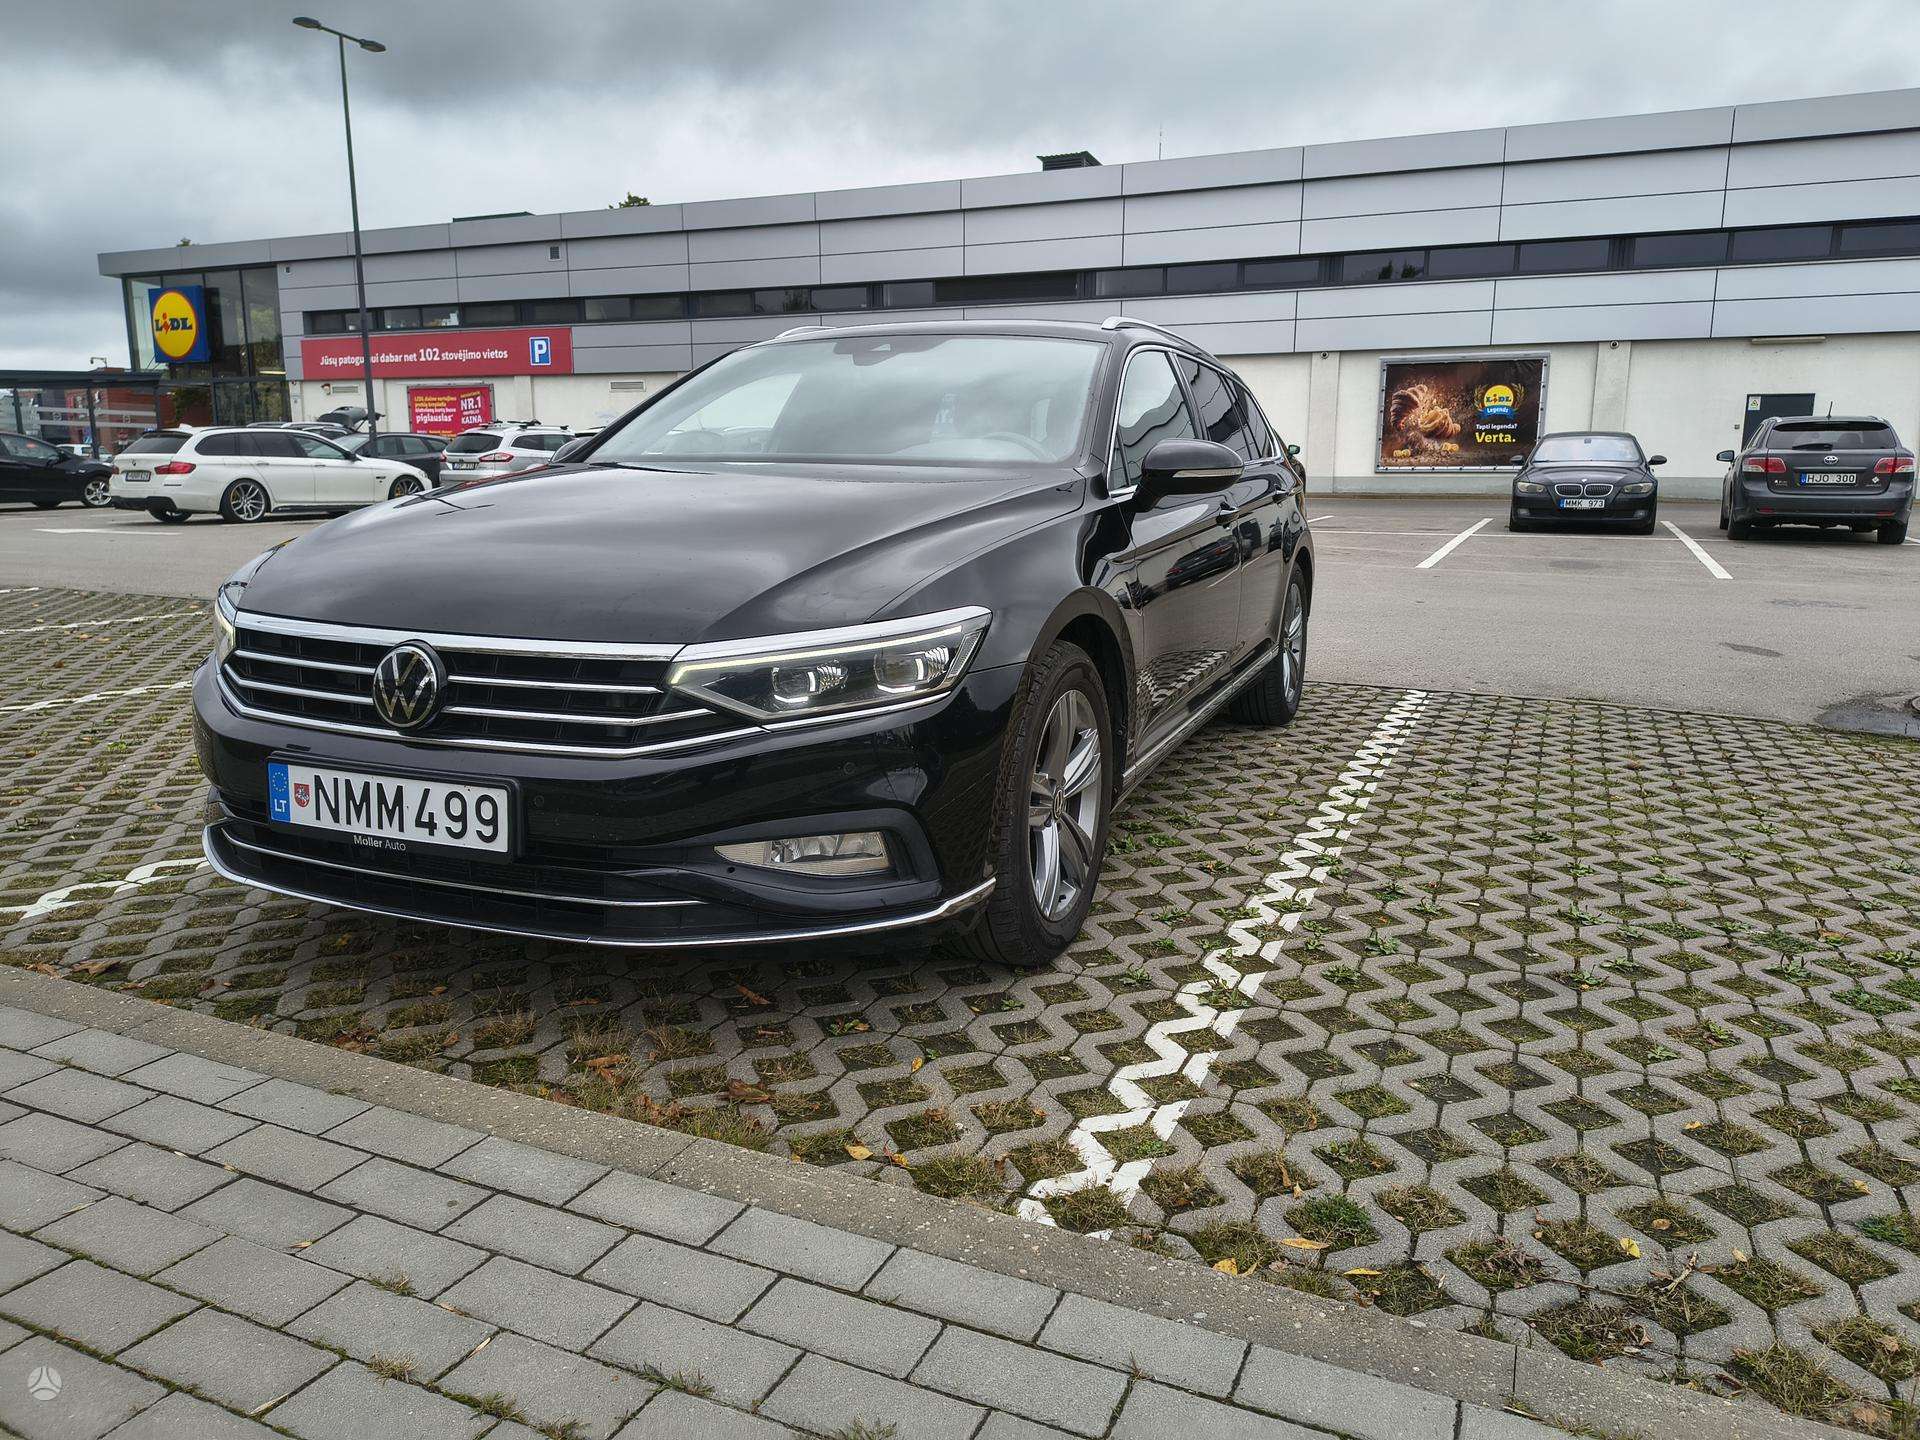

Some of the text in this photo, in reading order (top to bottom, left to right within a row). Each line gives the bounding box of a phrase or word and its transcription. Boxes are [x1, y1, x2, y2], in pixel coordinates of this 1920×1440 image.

[320, 347, 508, 367] Jūsų patoguui dabar net 102 stovėjimo vietos
[534, 340, 547, 362] P
[460, 396, 482, 411] NR.1
[1475, 432, 1516, 443] Verta.
[274, 798, 287, 813] LT
[384, 839, 406, 851] Auto
